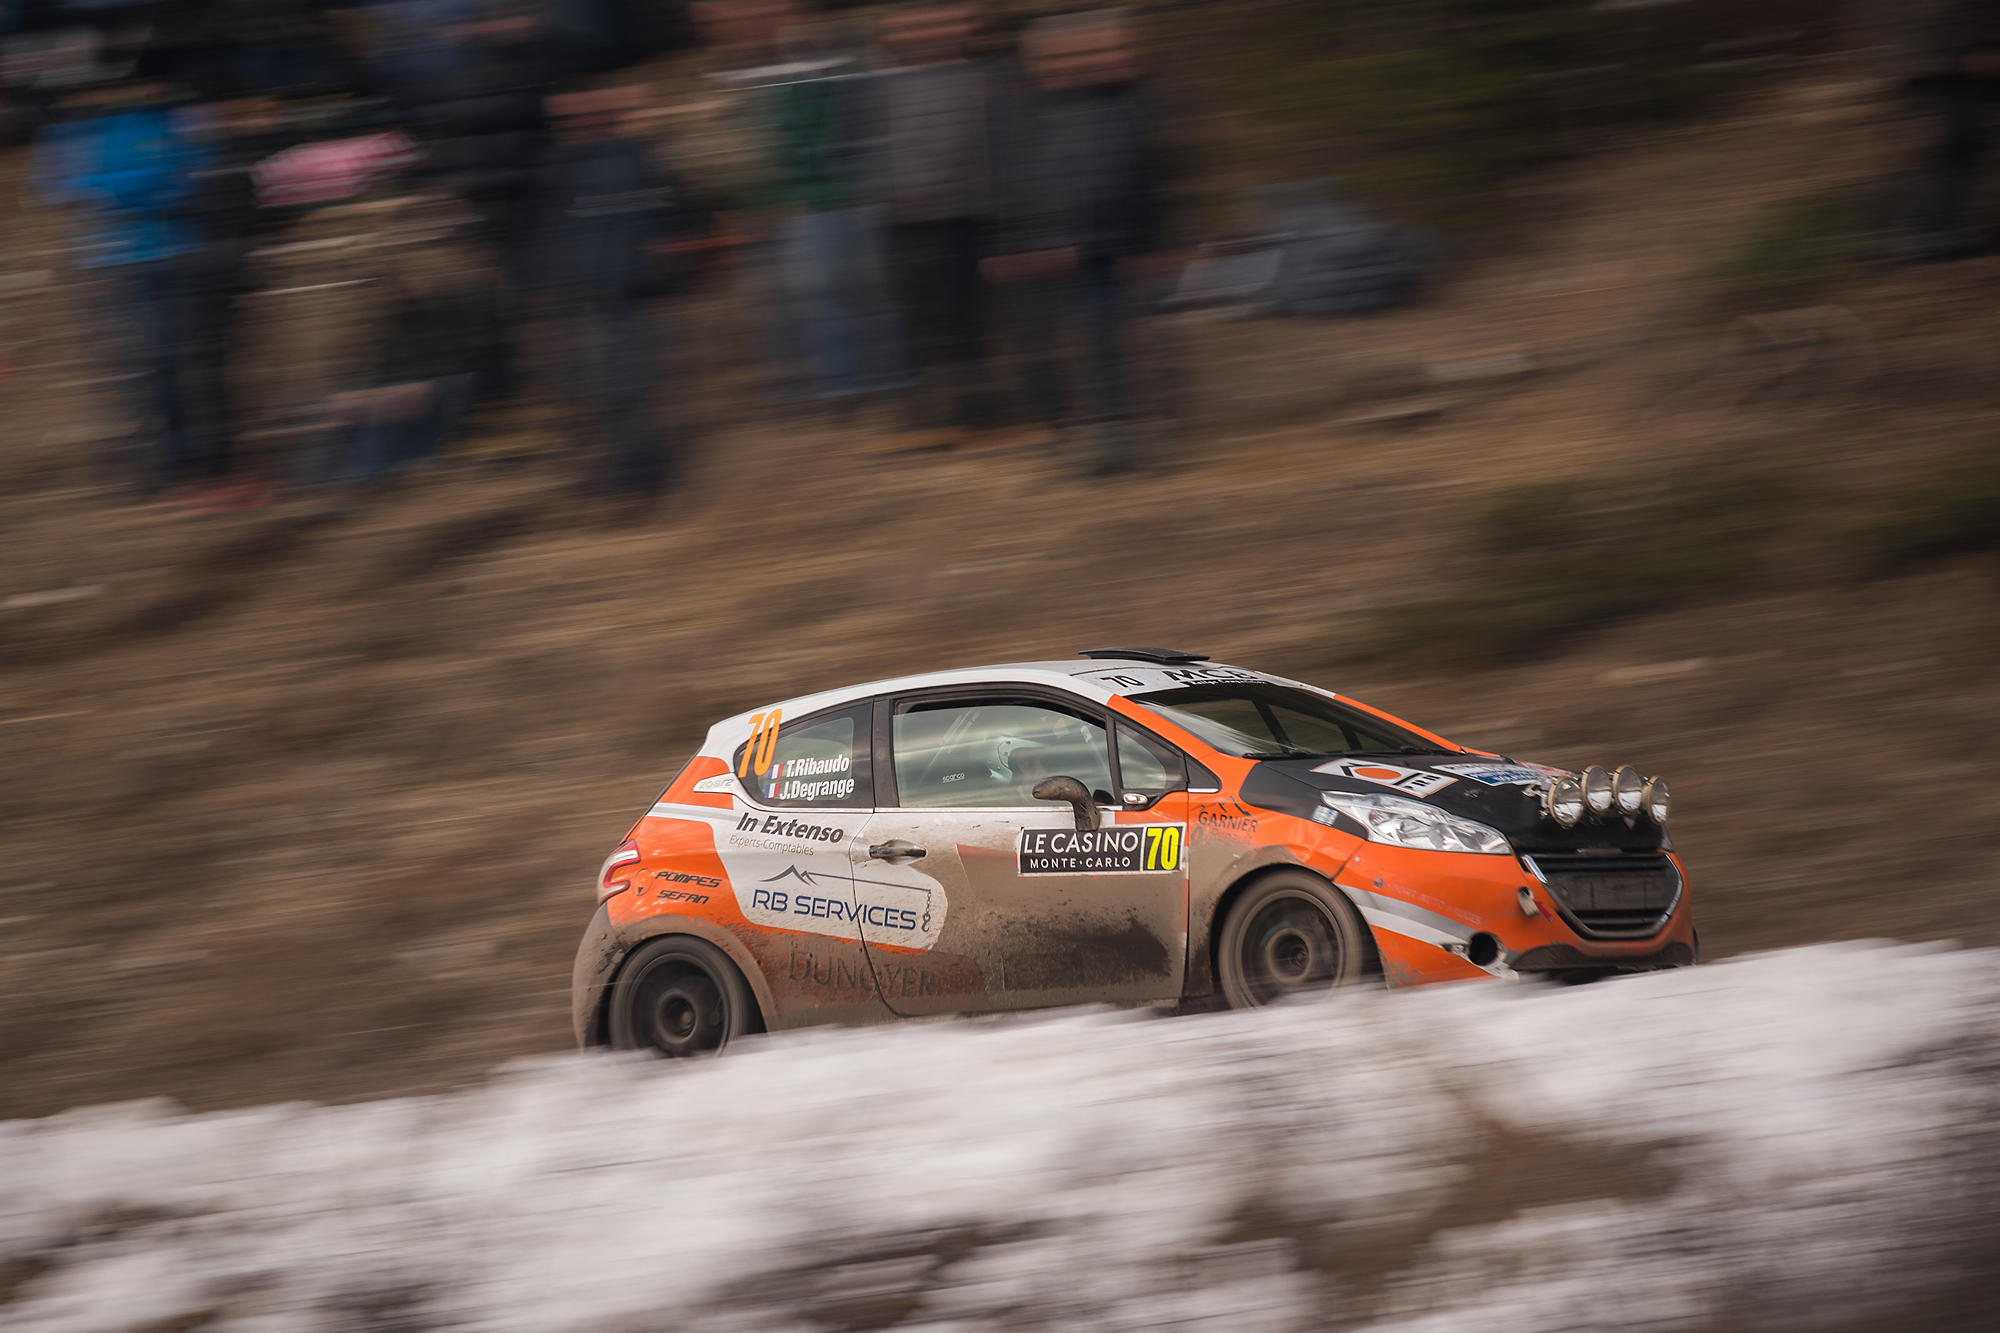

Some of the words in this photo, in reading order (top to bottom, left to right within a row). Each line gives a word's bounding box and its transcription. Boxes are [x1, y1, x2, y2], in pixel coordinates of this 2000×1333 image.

[1100, 675, 1145, 688] 70
[738, 708, 783, 779] 70
[786, 755, 850, 778] T.Ribaudo
[779, 778, 855, 801] J.Degrange
[735, 812, 759, 833] In
[760, 815, 845, 843] Extenso
[1198, 811, 1258, 833] GARNIER
[729, 835, 814, 857] Experts-Comptables
[1024, 834, 1047, 854] LE
[1050, 831, 1139, 853] CASINO
[1146, 826, 1180, 871] 70
[655, 871, 723, 888] POMPES
[657, 890, 710, 905] SEFAN
[752, 889, 788, 912] RB
[793, 895, 917, 931] SERVICES
[788, 951, 935, 997] DUNOYER
